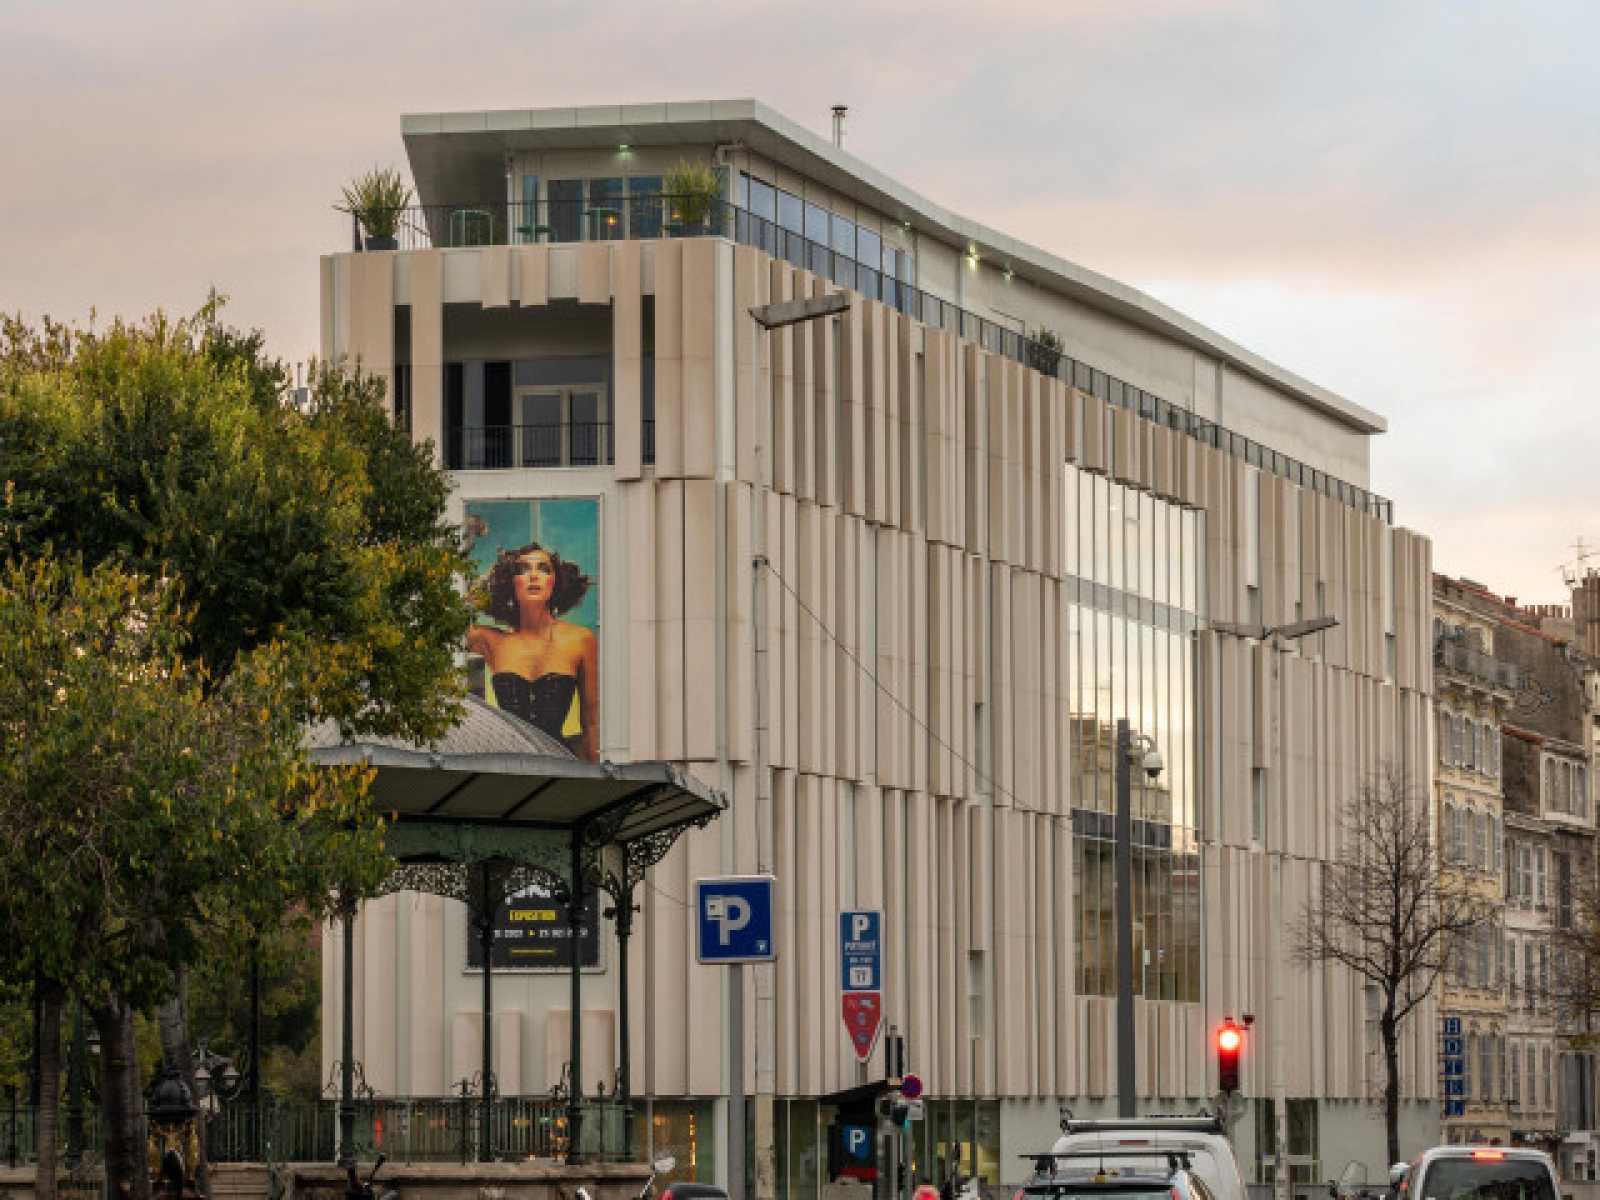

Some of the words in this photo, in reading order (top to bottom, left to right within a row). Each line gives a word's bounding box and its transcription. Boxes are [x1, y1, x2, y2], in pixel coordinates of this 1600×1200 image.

[719, 895, 751, 946] P
[852, 914, 870, 941] P
[850, 1129, 866, 1153] P
